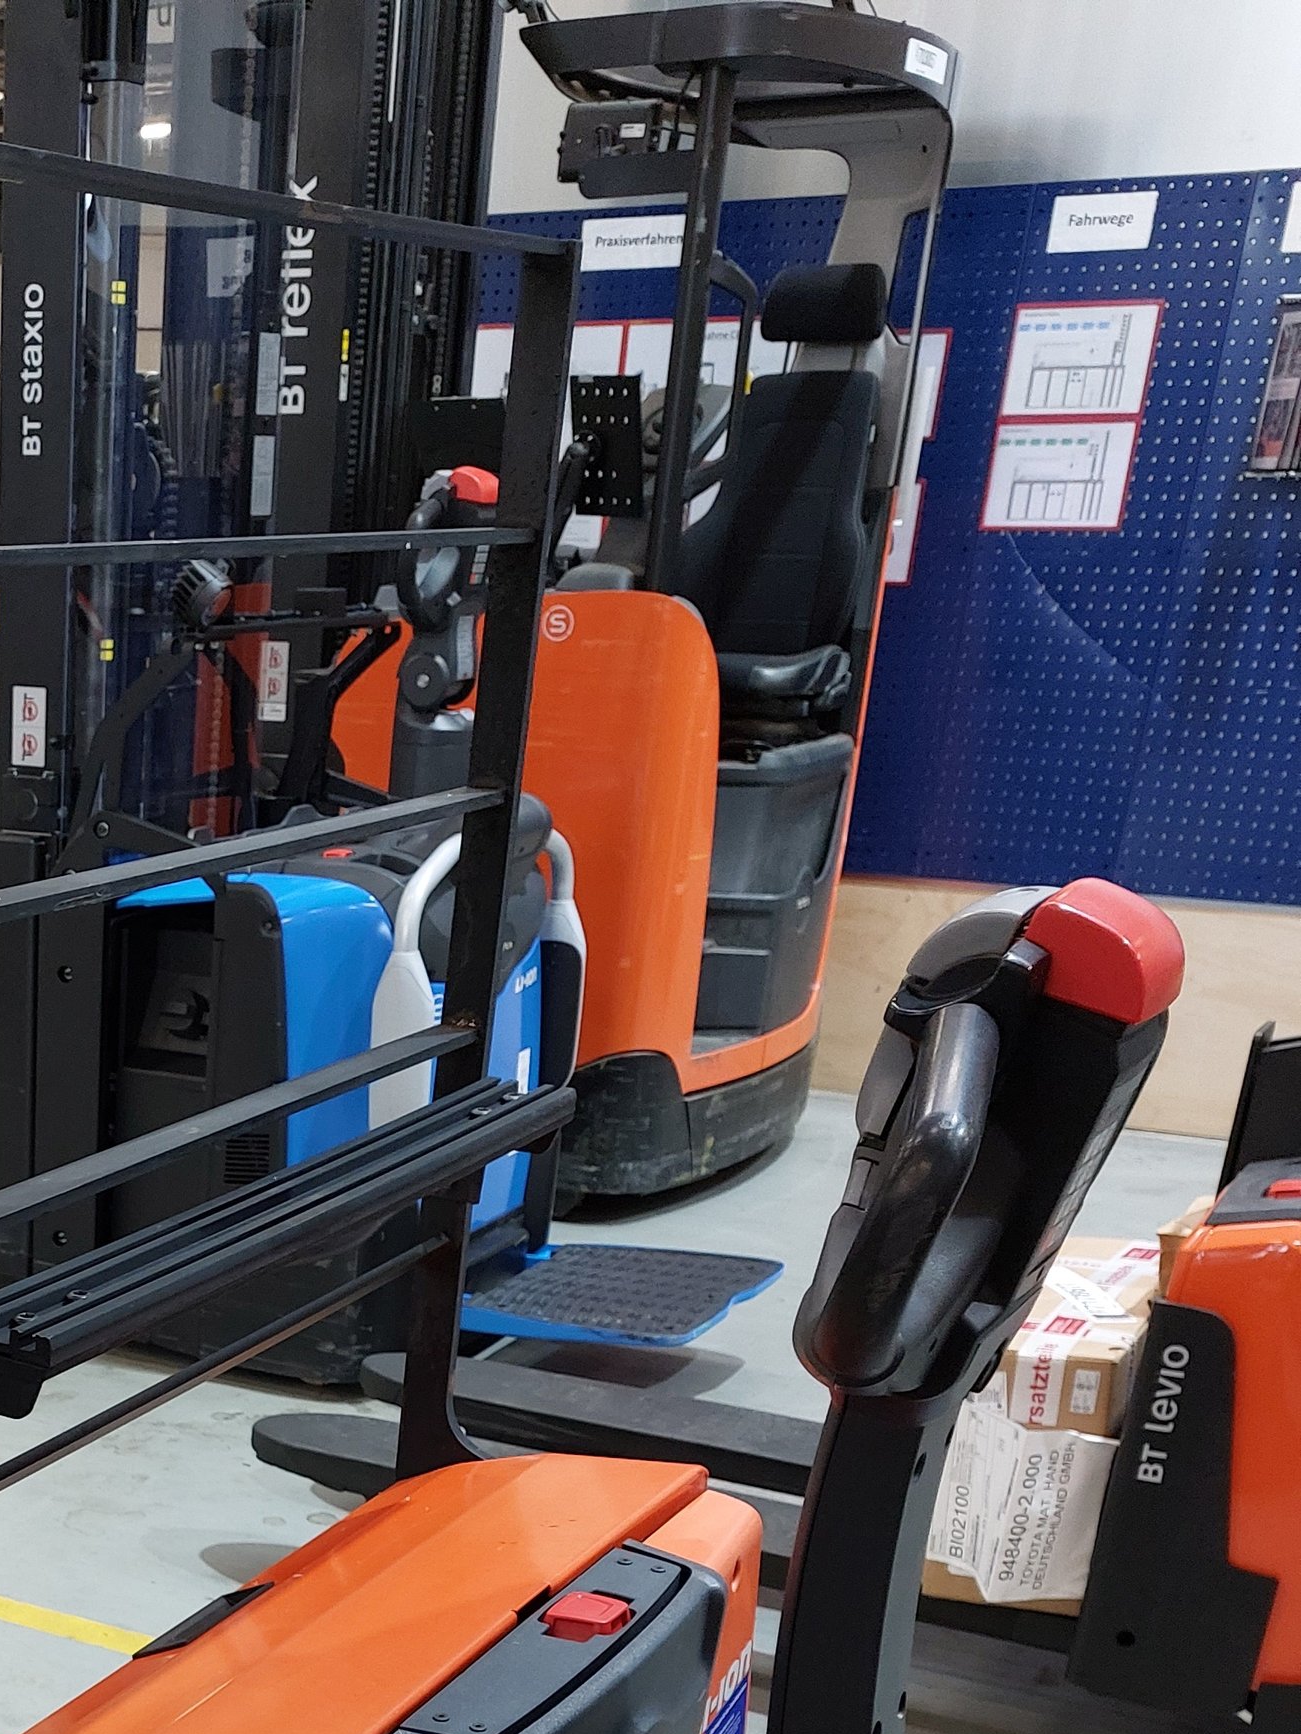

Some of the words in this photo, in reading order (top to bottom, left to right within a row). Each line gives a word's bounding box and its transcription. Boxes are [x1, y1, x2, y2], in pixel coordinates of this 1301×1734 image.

[595, 232, 684, 249] Praxisverfahren
[1068, 213, 1134, 228] Fahrwege
[20, 283, 45, 404] staxio
[277, 356, 307, 415] BT
[22, 415, 42, 456] BT
[1144, 1344, 1190, 1433] levio
[1137, 1443, 1168, 1484] BT
[1019, 1531, 1044, 1586] TOYOTA
